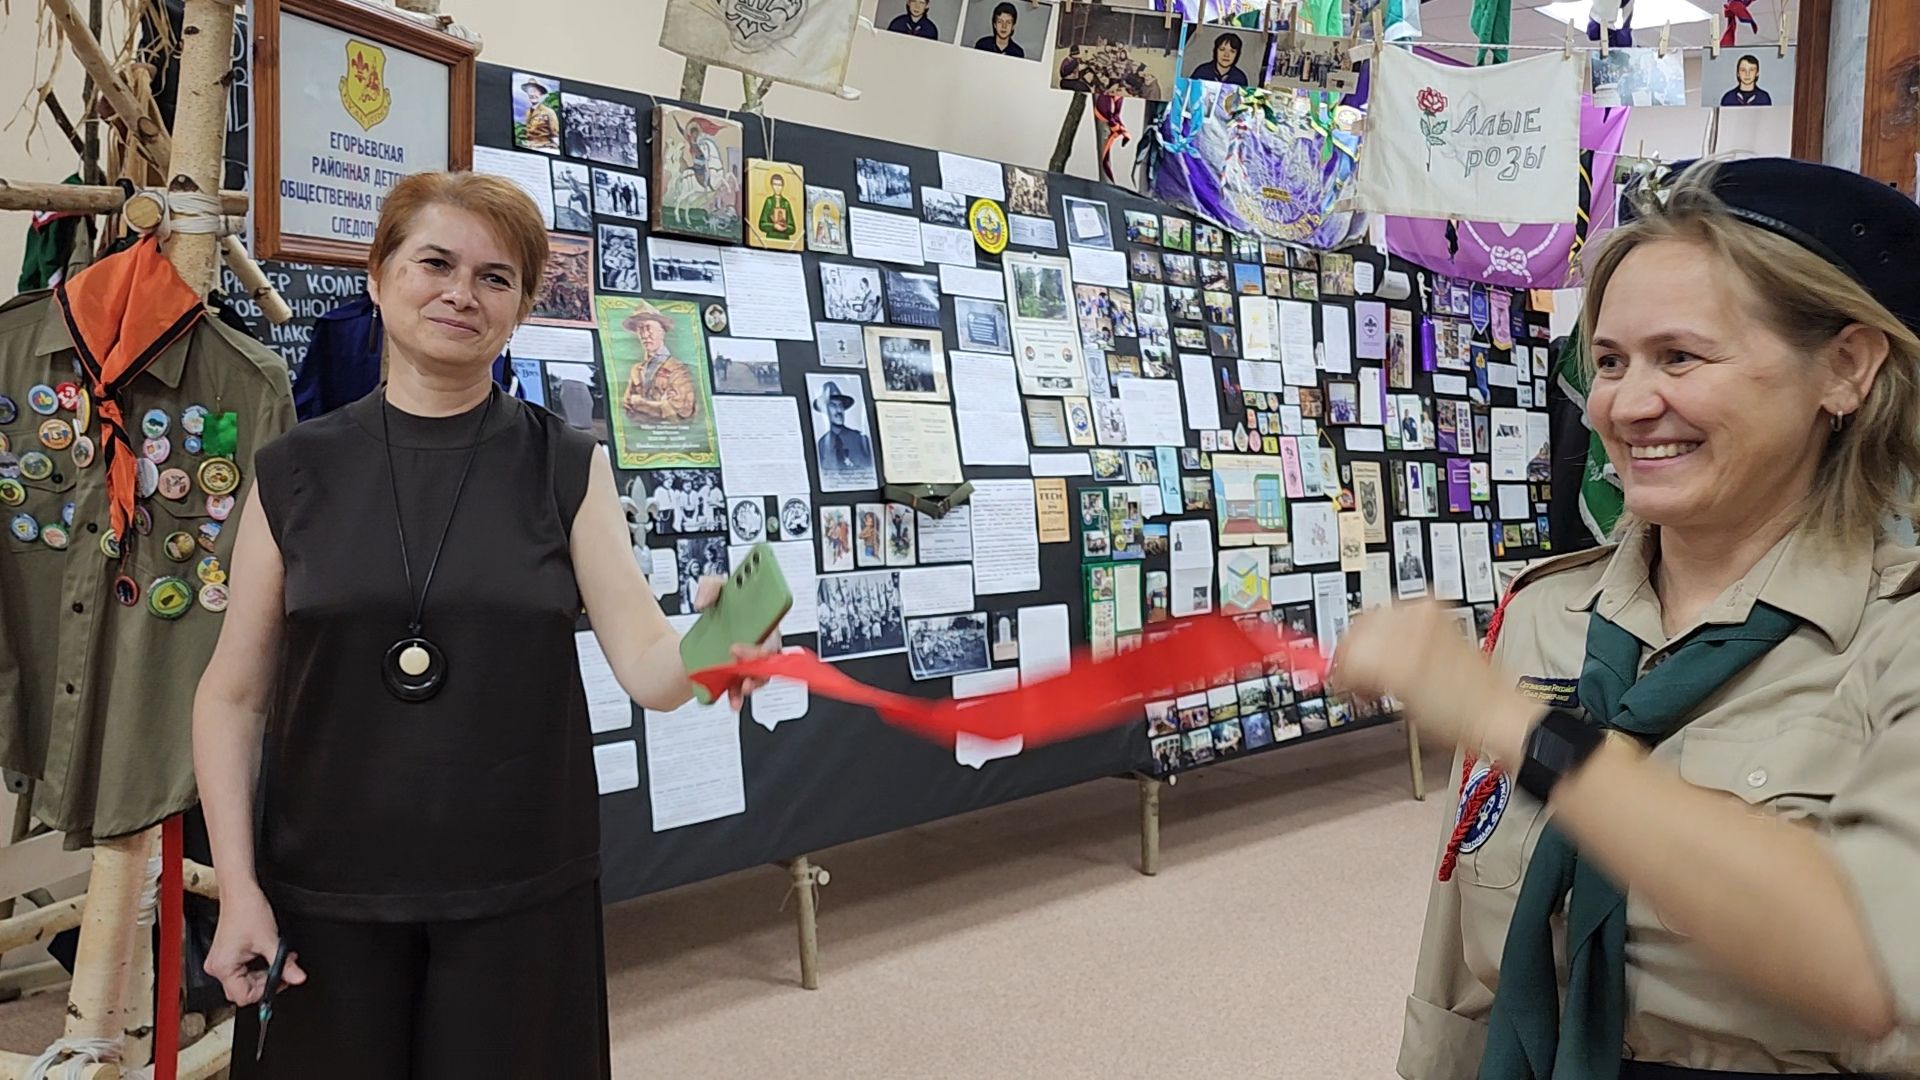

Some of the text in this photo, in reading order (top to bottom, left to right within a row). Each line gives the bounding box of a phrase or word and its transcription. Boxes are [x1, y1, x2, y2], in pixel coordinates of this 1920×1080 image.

[330, 131, 404, 164] ЕГОРЬЕВСКАЯ
[312, 156, 370, 184] РАЙОННАЯ
[280, 179, 372, 211] ОБЩЕСТВЕННАЯ
